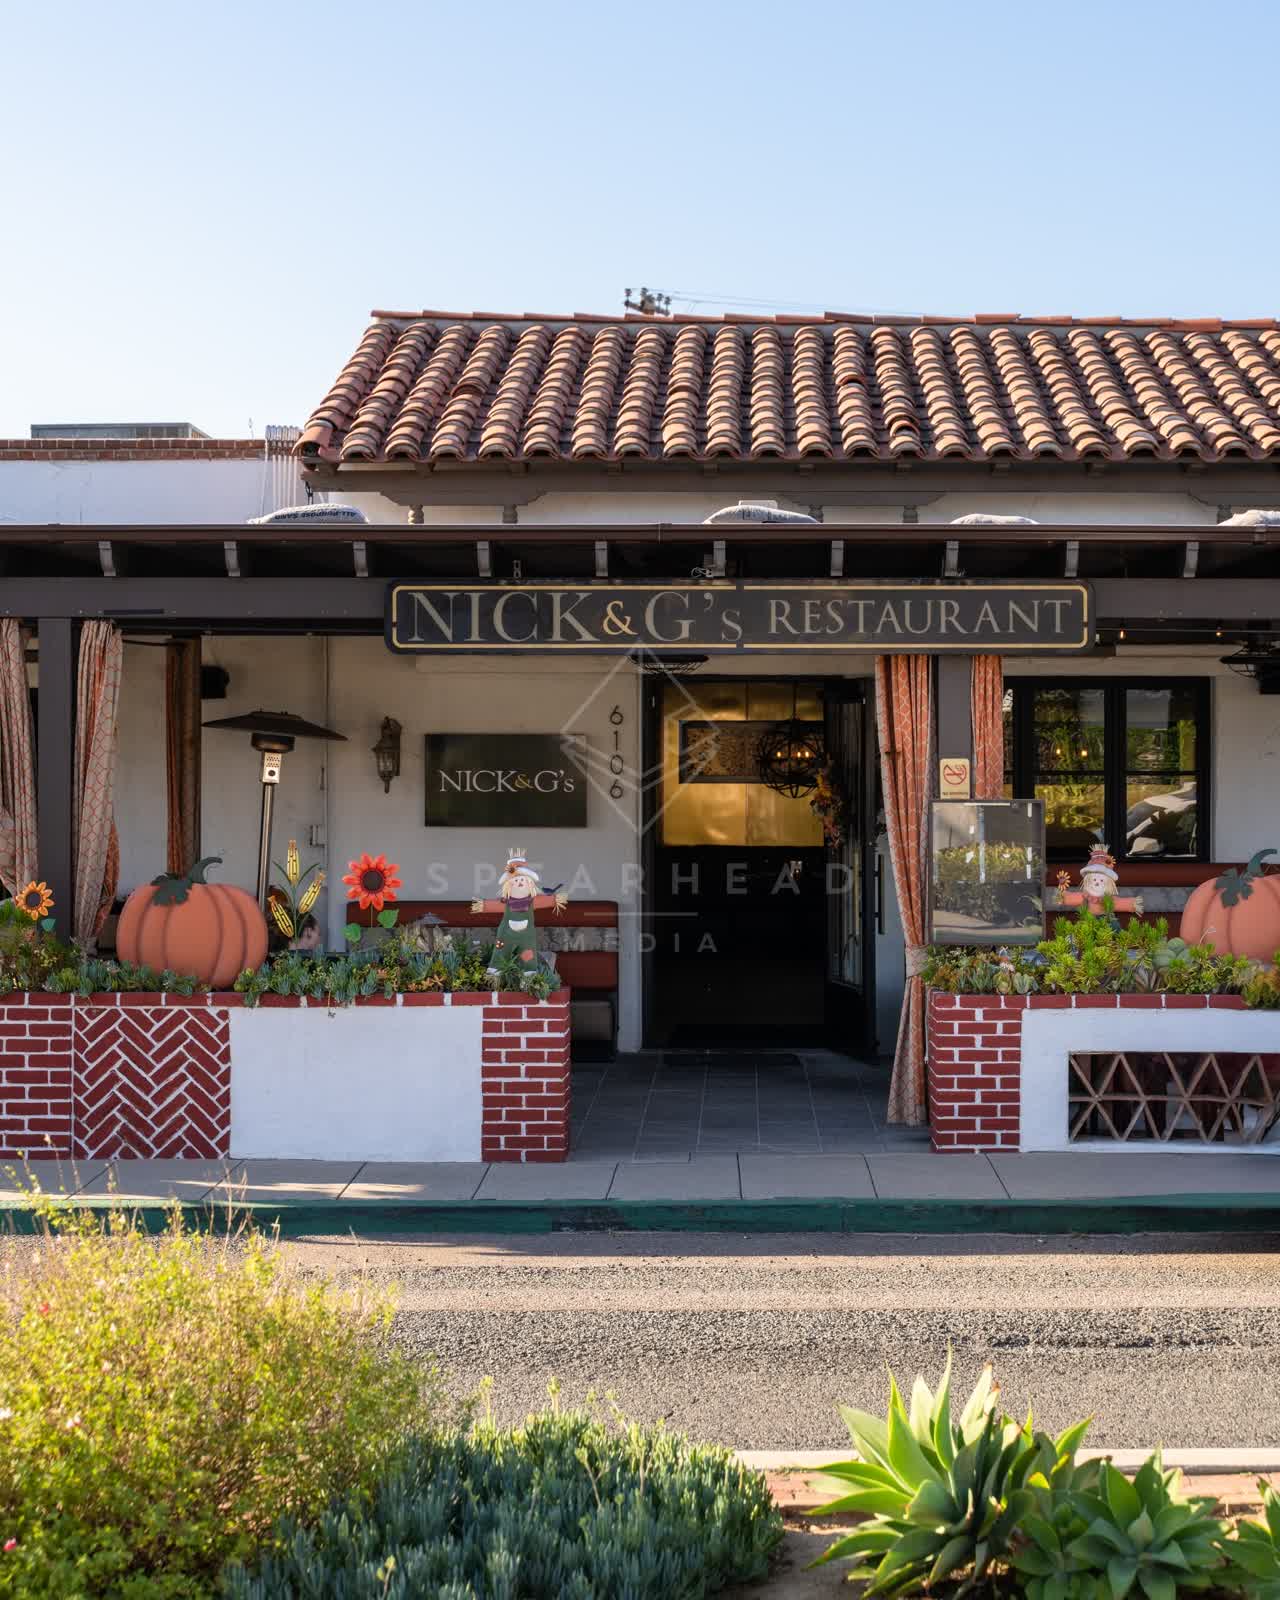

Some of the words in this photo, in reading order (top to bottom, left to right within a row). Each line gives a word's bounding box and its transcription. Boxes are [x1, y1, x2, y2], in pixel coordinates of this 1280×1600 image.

[767, 599, 1072, 634] RESTAURANT
[608, 704, 625, 800] 6106
[438, 768, 576, 793] NICK&G's
